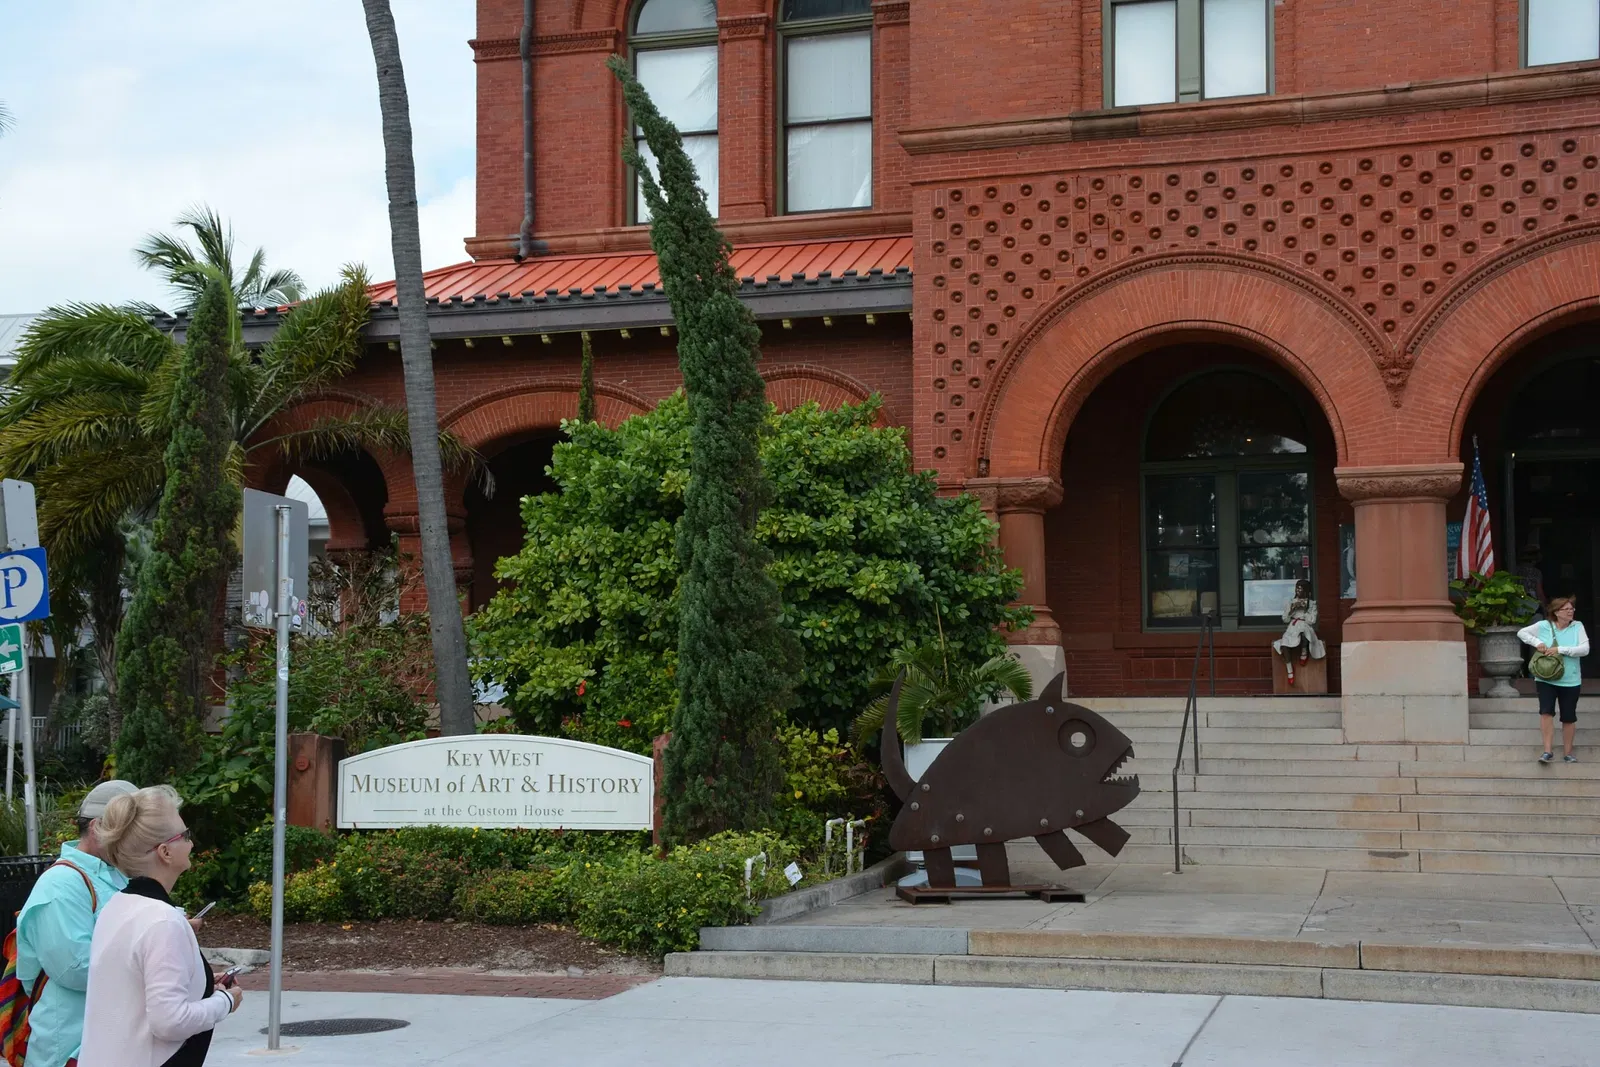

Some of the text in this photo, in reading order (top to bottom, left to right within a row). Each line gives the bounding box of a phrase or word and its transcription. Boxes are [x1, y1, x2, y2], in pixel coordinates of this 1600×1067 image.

[0, 566, 27, 609] P
[446, 749, 544, 767] KEY WEST
[350, 773, 642, 793] MUSEUM of ART & HISTORY
[424, 805, 564, 816] at the Custom House
